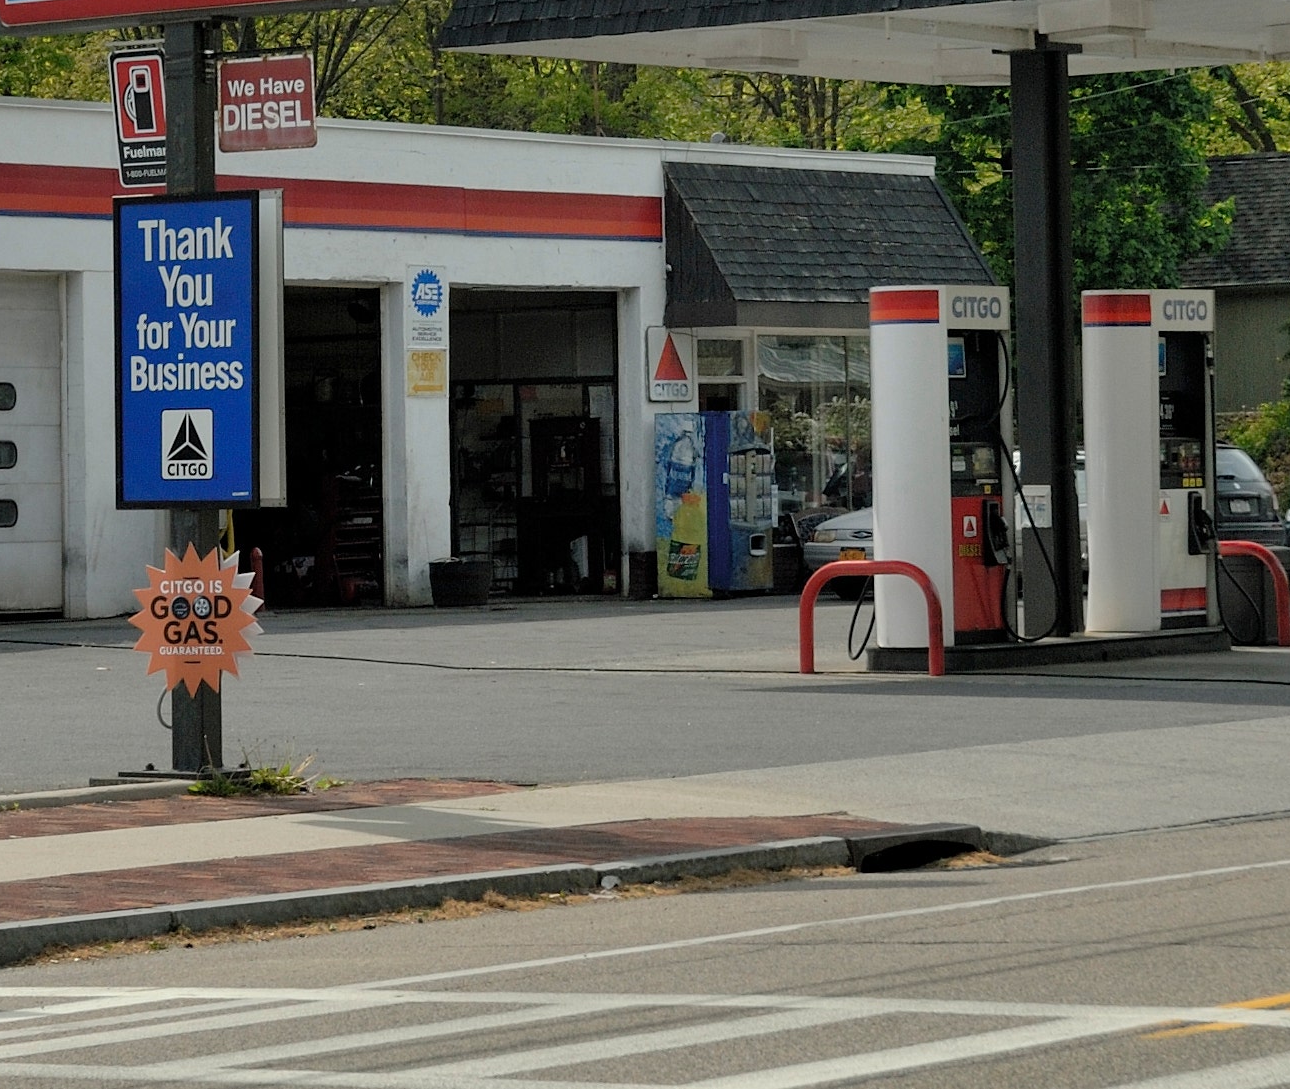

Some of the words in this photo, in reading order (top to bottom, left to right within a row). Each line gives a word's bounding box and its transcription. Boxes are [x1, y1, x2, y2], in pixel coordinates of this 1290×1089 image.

[227, 79, 255, 98] We
[259, 77, 305, 96] Have
[223, 100, 311, 132] DIESEL
[137, 216, 234, 262] Thank
[158, 265, 213, 308] You
[415, 282, 439, 300] ASE
[952, 295, 1002, 319] CITGO
[1163, 299, 1208, 321] CITGO
[136, 313, 173, 350] for
[178, 312, 236, 349] Your
[130, 352, 244, 393] Business
[167, 462, 208, 478] CITGO
[160, 580, 205, 595] CITGO
[209, 579, 223, 593] IS
[150, 595, 232, 620] GOOD
[163, 621, 223, 644] GAS.
[159, 646, 225, 656] GUARANTEED.
